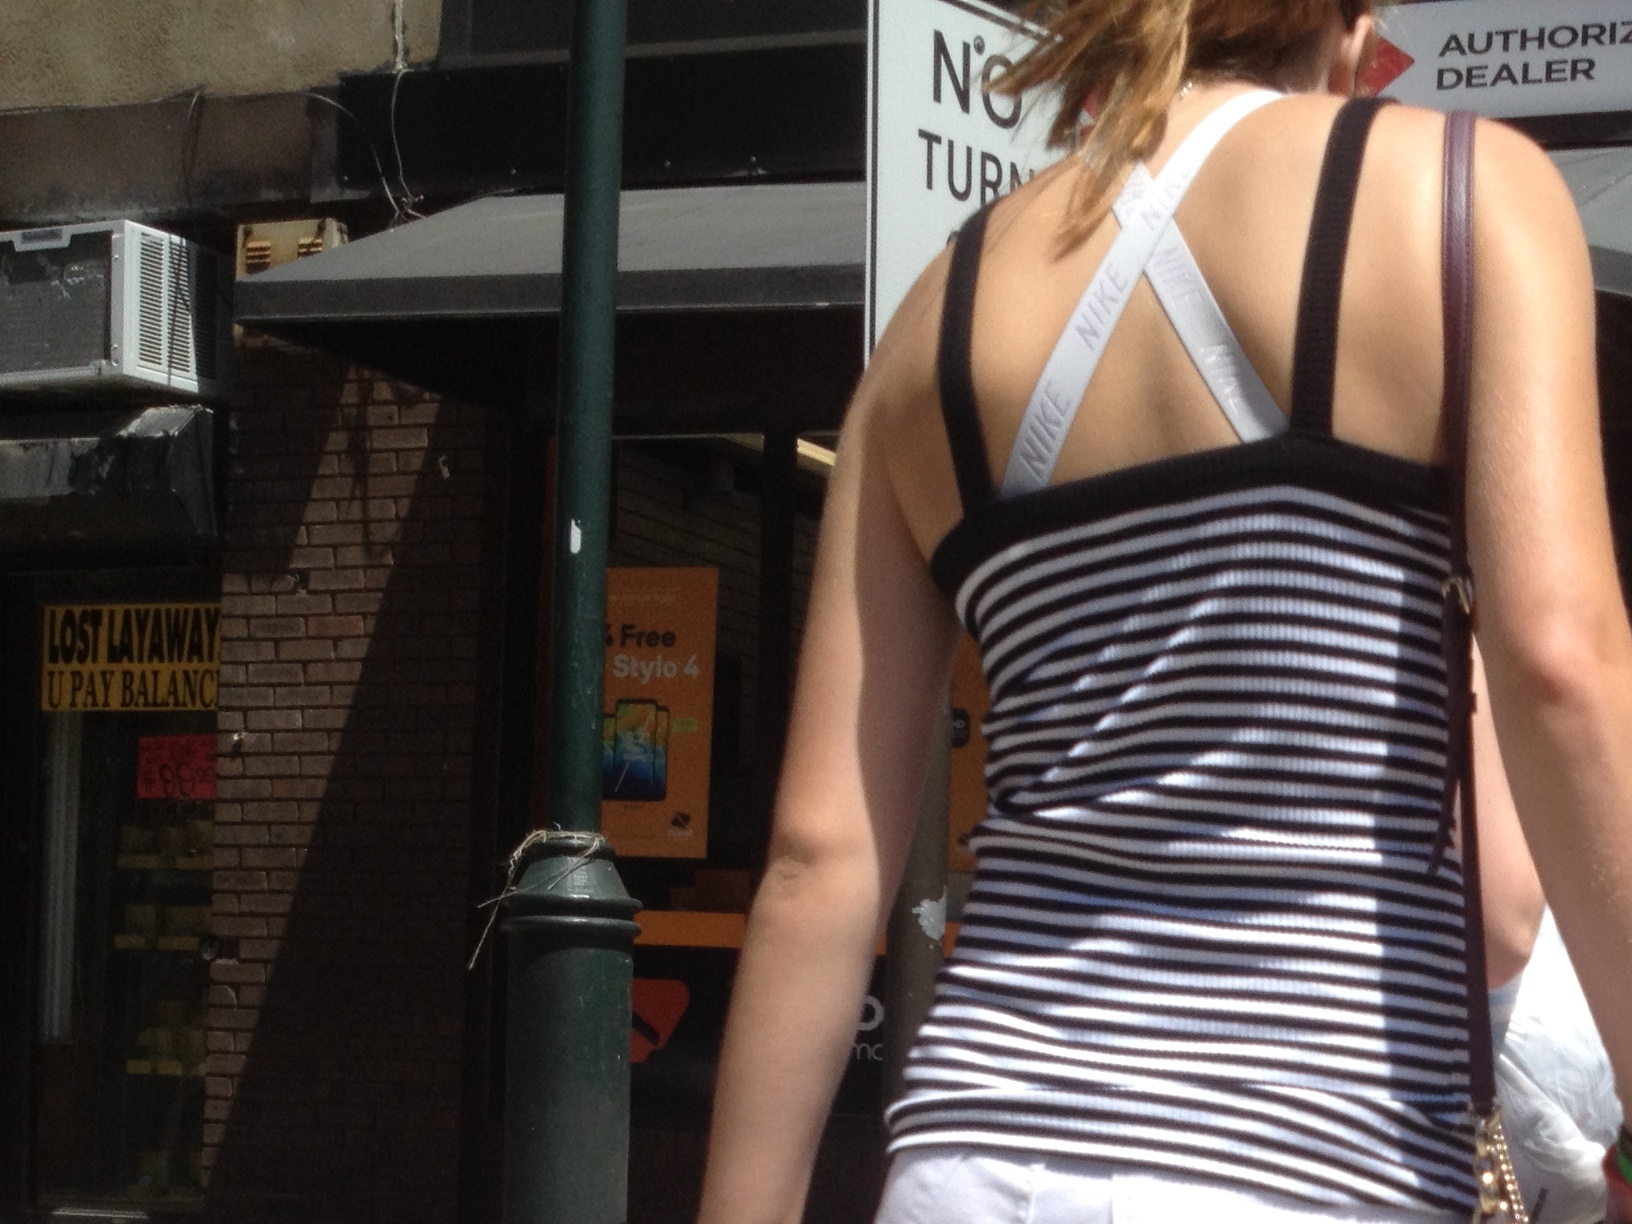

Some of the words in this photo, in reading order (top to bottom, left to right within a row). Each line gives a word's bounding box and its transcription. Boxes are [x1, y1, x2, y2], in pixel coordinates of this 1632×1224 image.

[932, 29, 1023, 129] NO
[1436, 57, 1596, 90] DEALER
[1075, 261, 1130, 351] NIKE
[1019, 379, 1071, 480] NIKE
[48, 608, 103, 664] LOST
[107, 608, 220, 663] LAYAWAY
[619, 624, 676, 648] Free
[47, 670, 64, 708] U
[69, 670, 115, 708] PAY
[120, 669, 220, 707] BALANC
[613, 654, 676, 685] Stylo
[683, 655, 700, 679] 4
